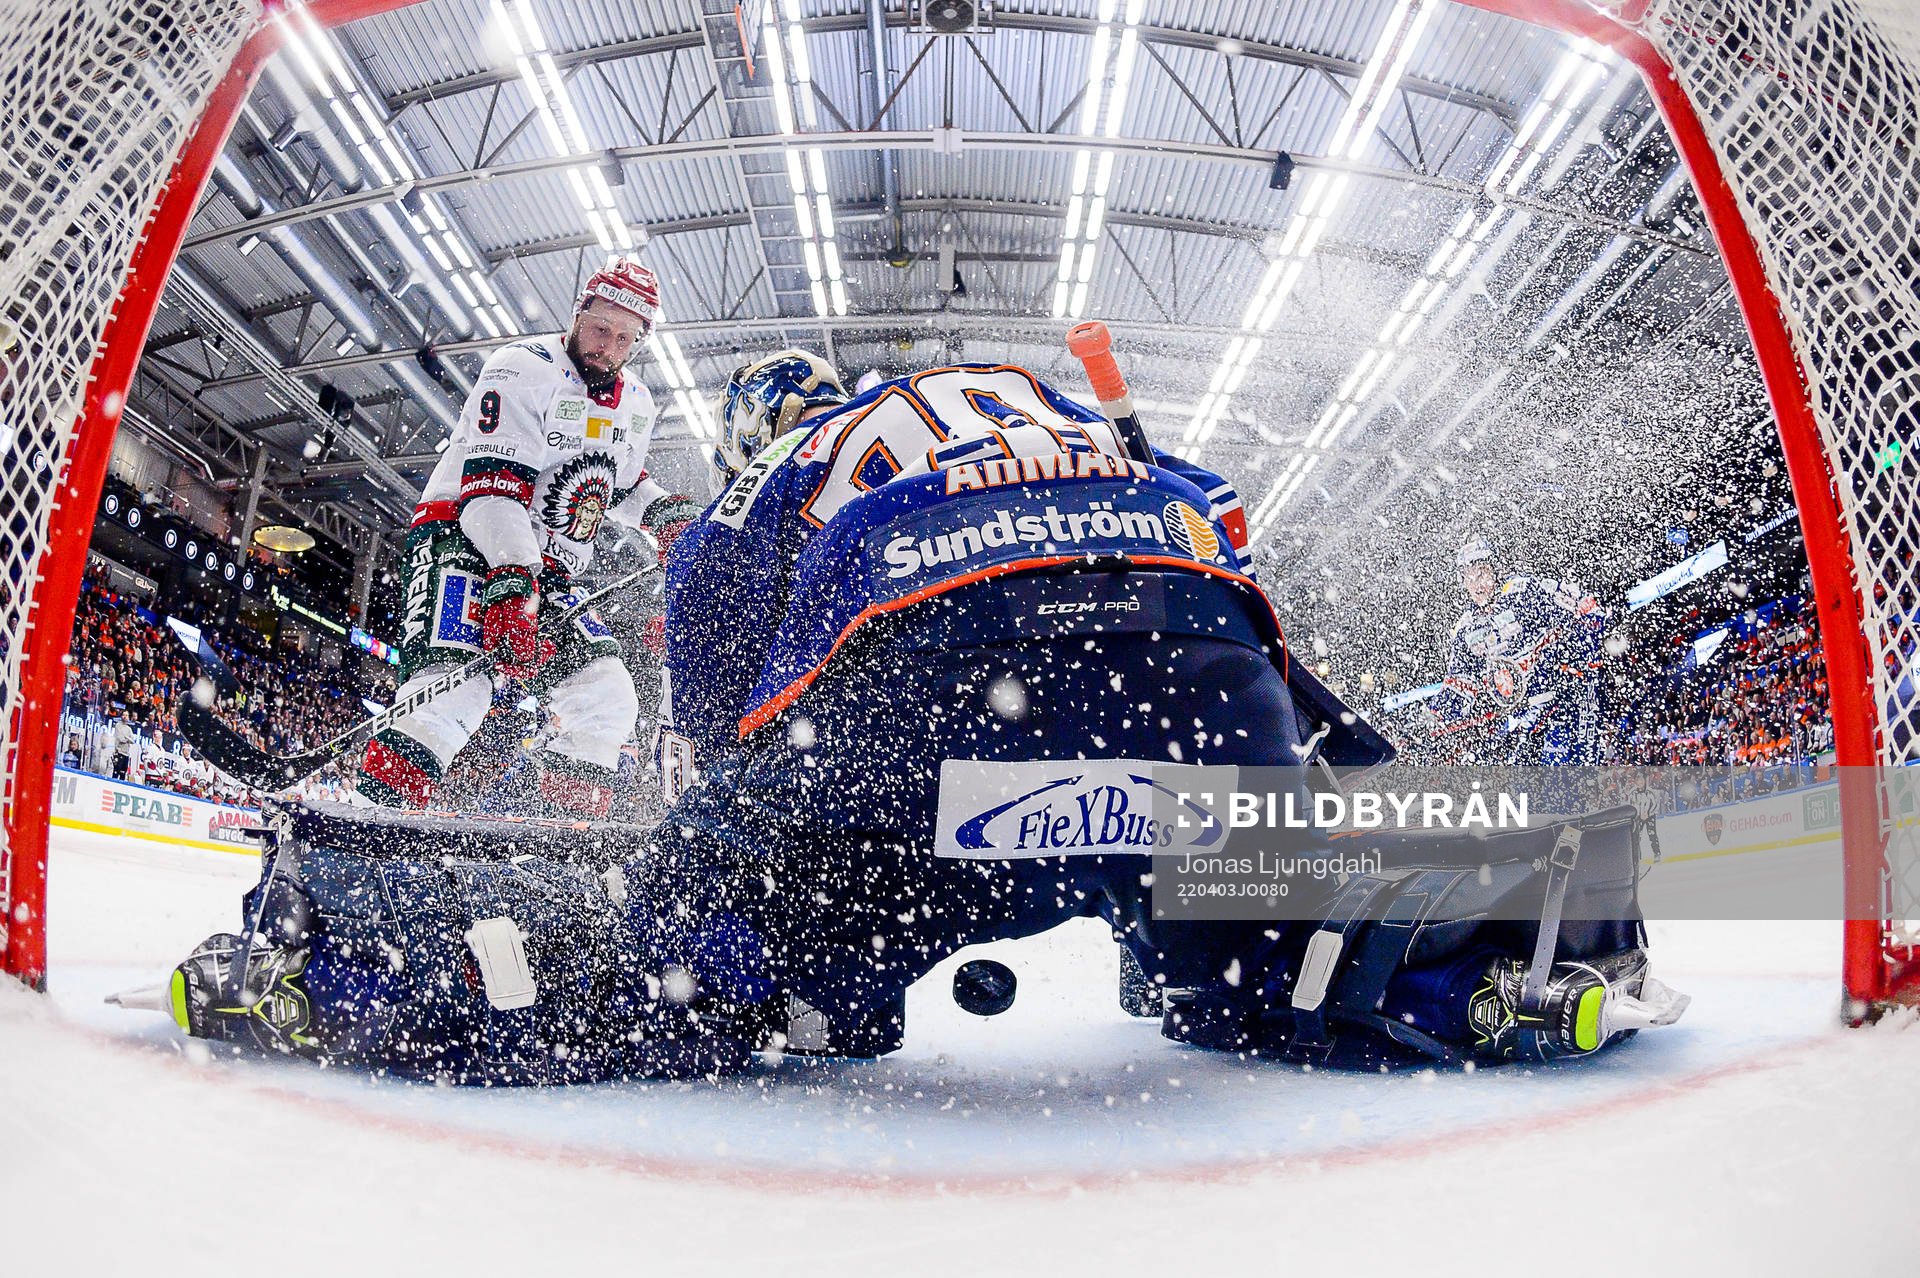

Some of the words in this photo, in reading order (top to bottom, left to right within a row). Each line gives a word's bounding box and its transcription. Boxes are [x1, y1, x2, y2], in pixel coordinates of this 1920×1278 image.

[477, 389, 501, 434] 9
[883, 501, 1169, 579] Sundström
[1037, 602, 1098, 615] CCM
[1104, 601, 1140, 612] PRO
[112, 791, 183, 825] PEAB
